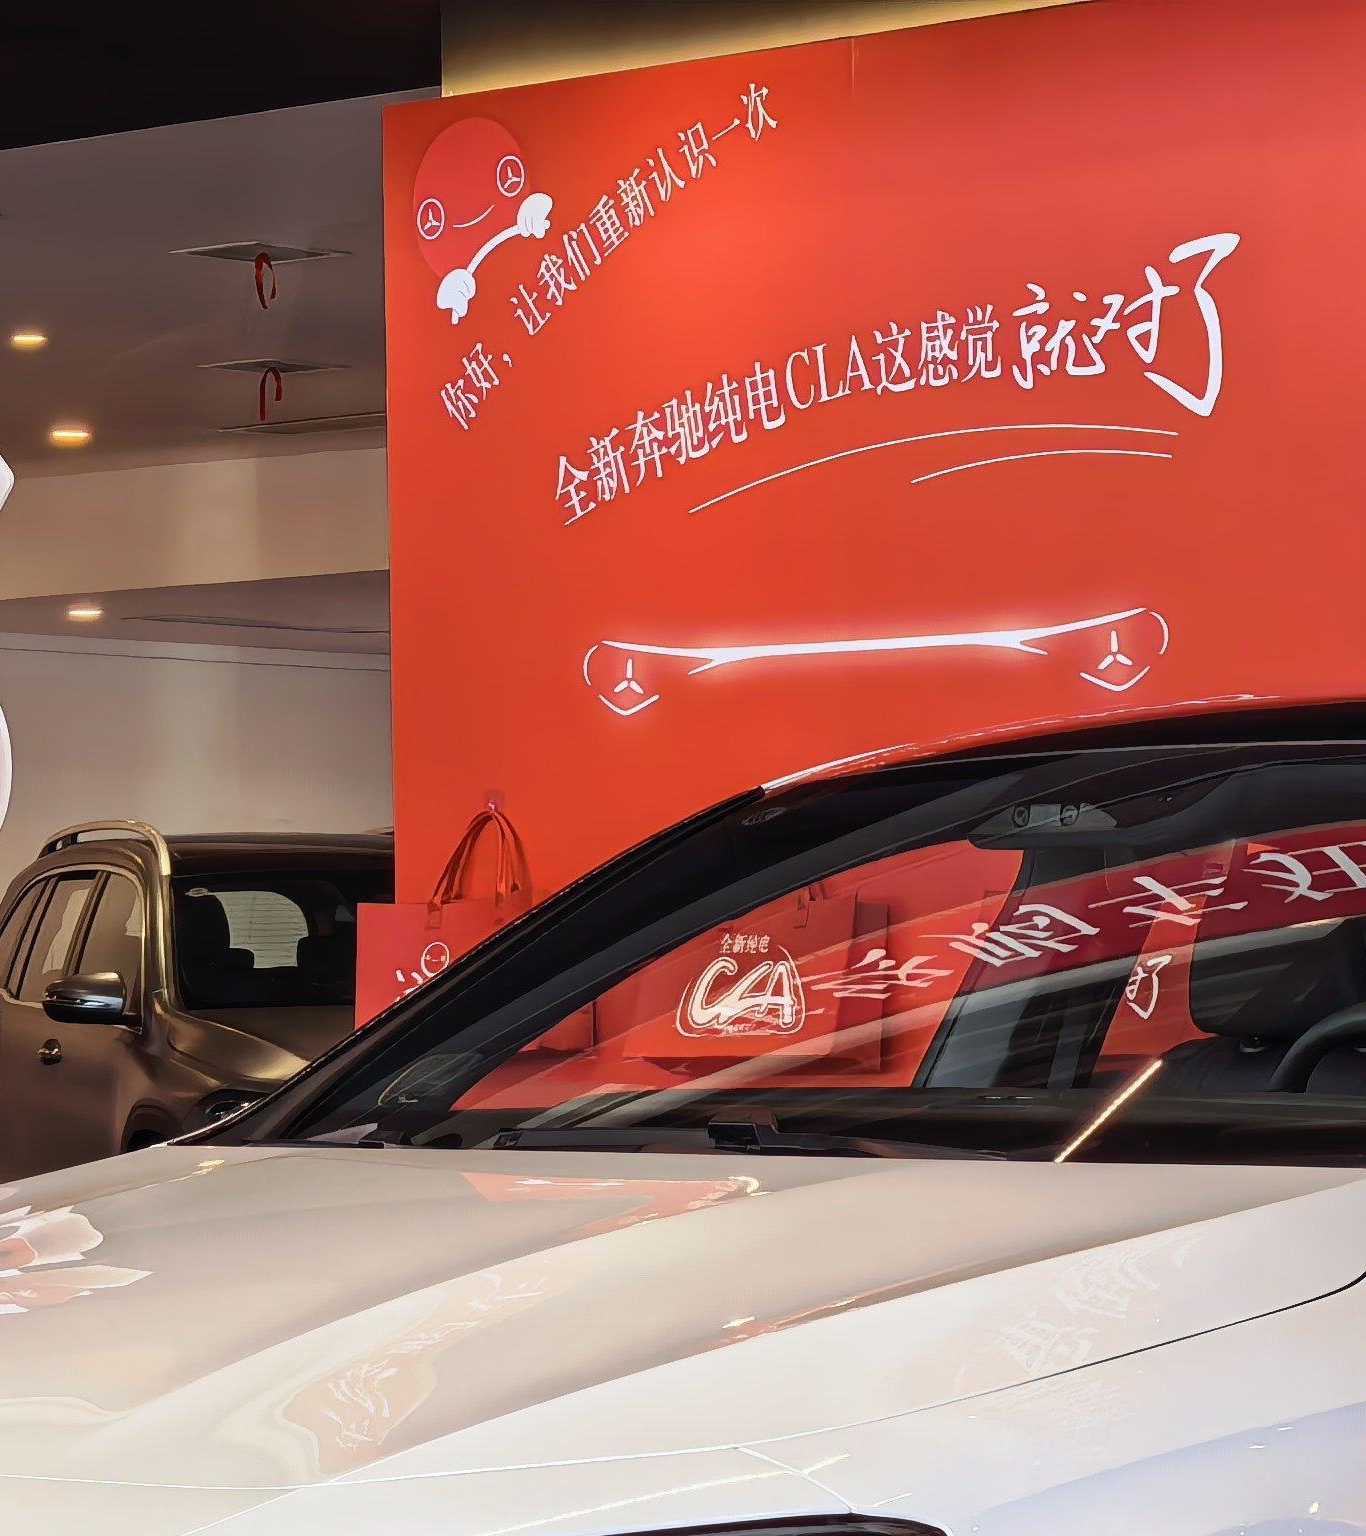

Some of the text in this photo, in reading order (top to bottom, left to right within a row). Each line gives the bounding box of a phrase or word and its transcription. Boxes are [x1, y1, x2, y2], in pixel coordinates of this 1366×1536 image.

[440, 83, 777, 431] 你好，让我们重新认识一次
